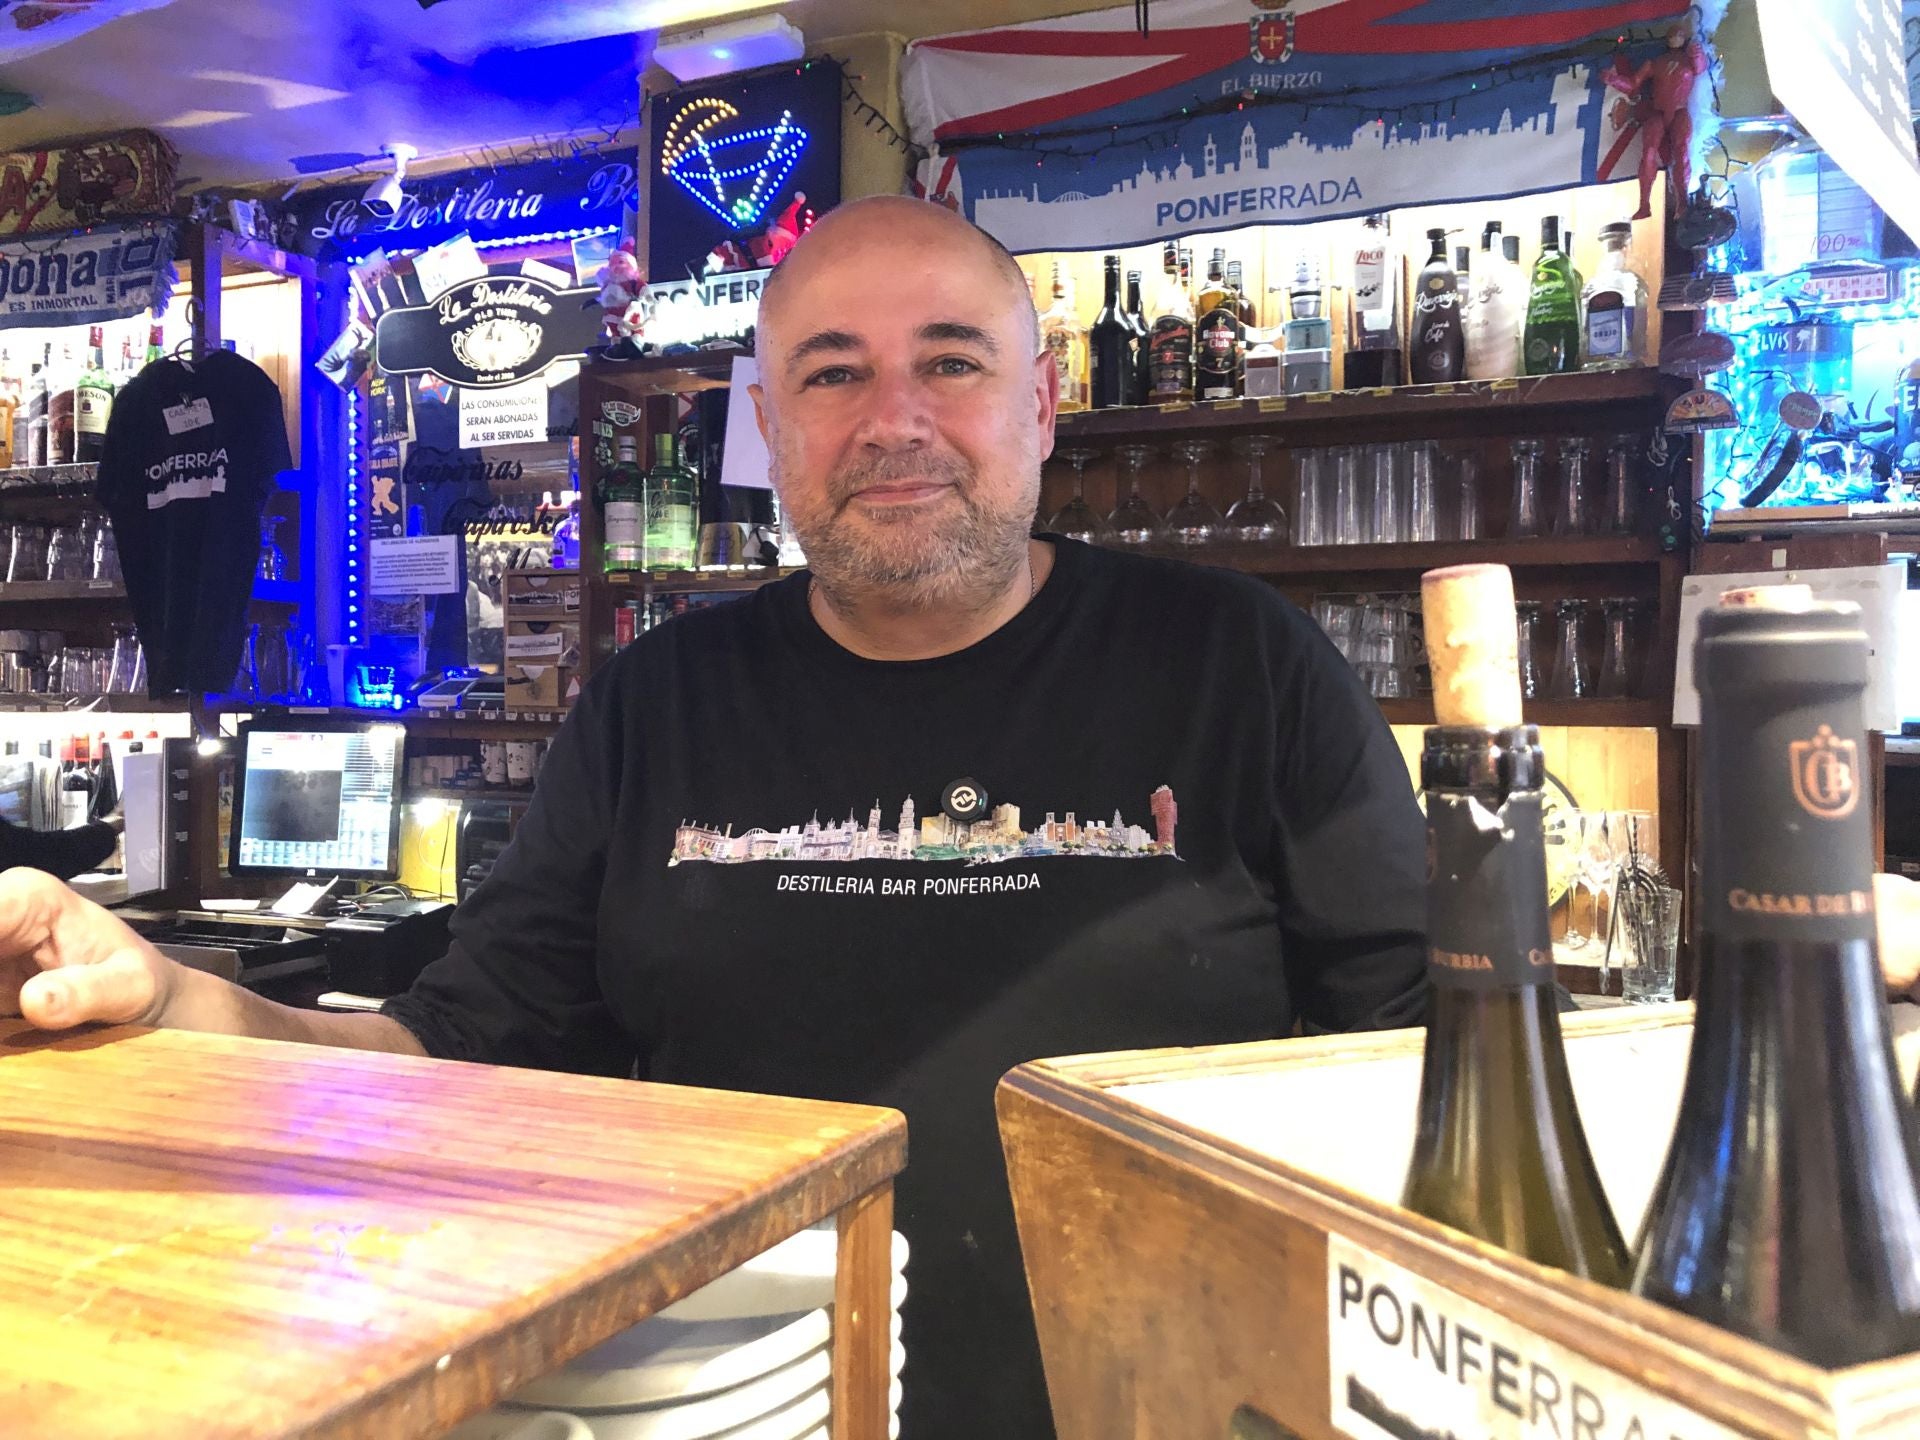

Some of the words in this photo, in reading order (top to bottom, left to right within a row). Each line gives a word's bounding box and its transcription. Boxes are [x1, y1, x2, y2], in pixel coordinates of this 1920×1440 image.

[1221, 78, 1245, 96] EL
[1250, 71, 1323, 90] BIERZO
[1156, 176, 1363, 227] PONFERRADA
[9, 300, 26, 312] ES
[32, 294, 98, 311] INMORTAL
[1210, 338, 1230, 348] Club
[461, 401, 475, 410] LAS
[477, 394, 541, 409] CONSUMICIONE
[466, 416, 492, 426] SERAN
[494, 414, 538, 423] ABONADAS
[470, 432, 480, 441] AL
[481, 431, 496, 441] SER
[497, 429, 534, 440] SERVIDAS
[776, 875, 875, 894] DESTILERIA
[881, 879, 916, 895] BAR
[923, 873, 1041, 895] PONFERRADA
[1338, 1262, 1682, 1440] PONFERRA
